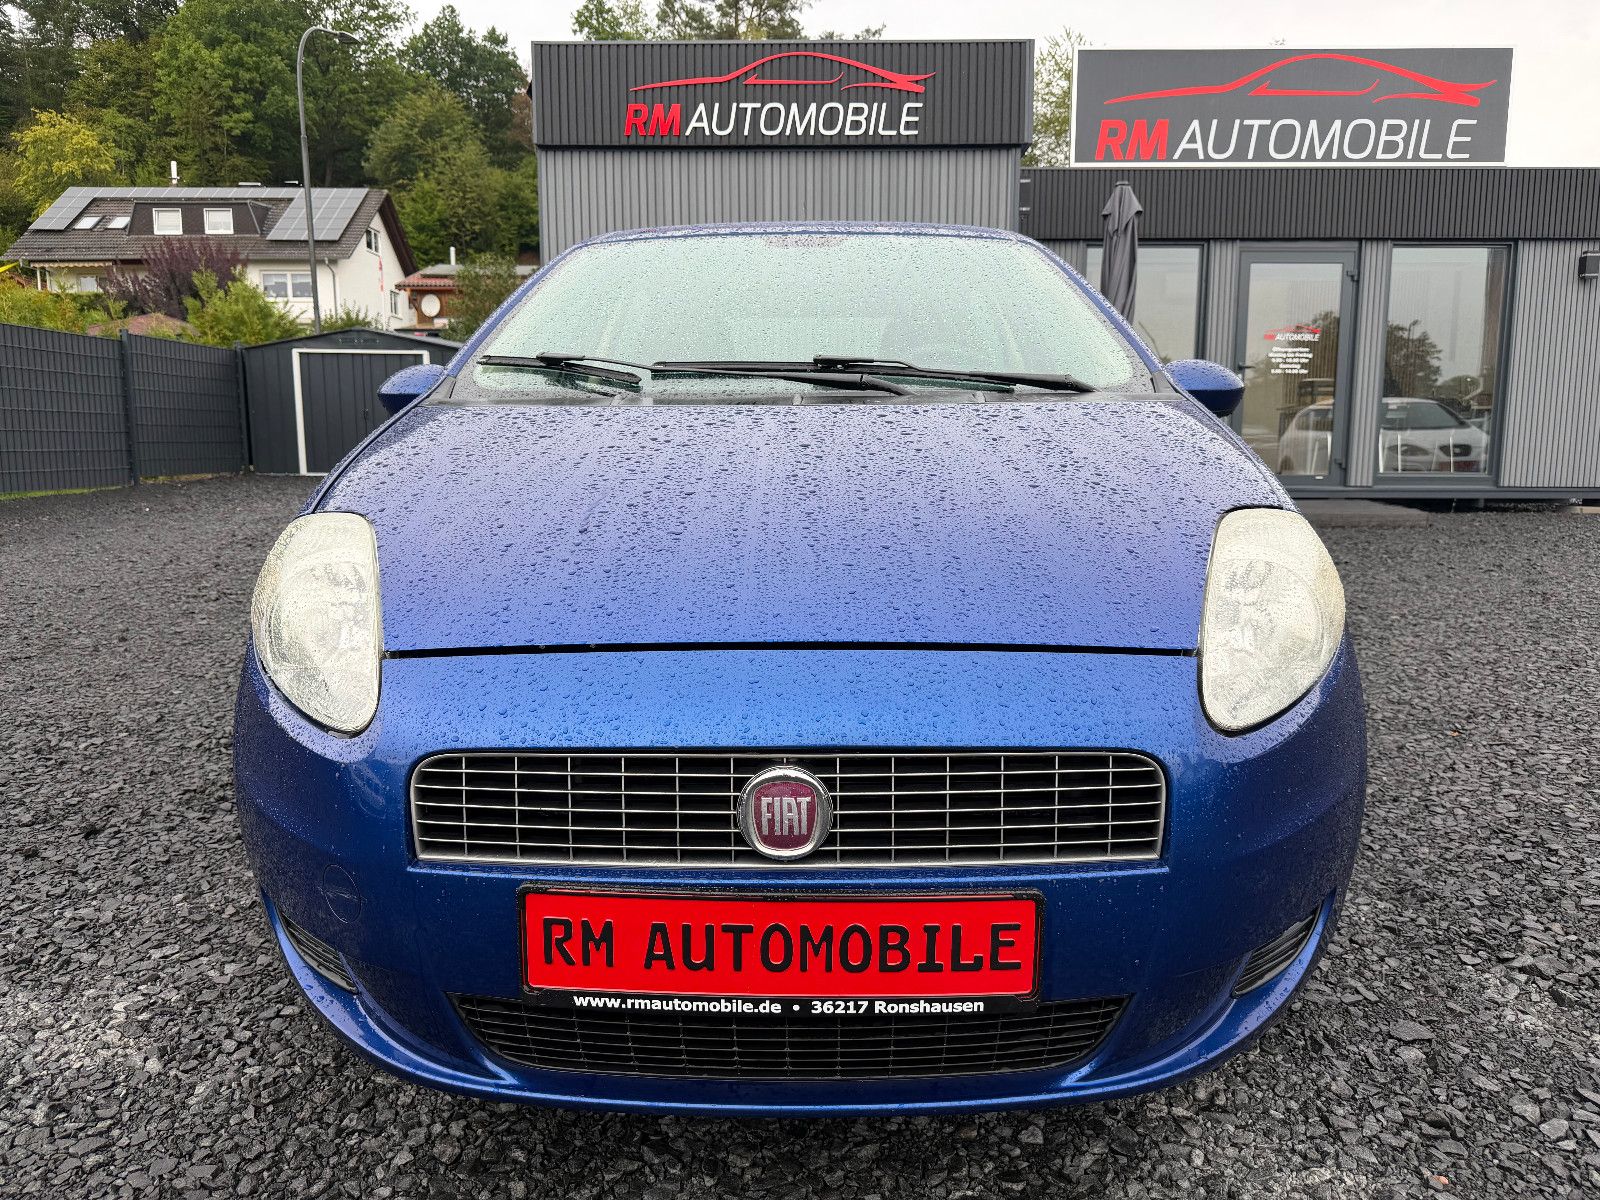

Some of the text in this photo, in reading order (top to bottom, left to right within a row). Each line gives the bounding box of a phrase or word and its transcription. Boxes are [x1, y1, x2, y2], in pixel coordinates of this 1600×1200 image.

[624, 101, 924, 137] RM AUTOMOBILE
[1094, 118, 1478, 161] RM AUTOMOBILE
[761, 797, 811, 836] FIAT
[542, 916, 1023, 973] RM AUTOMOBILE
[573, 994, 985, 1015] www.rmautomobile.de 36217 Ronshausen
